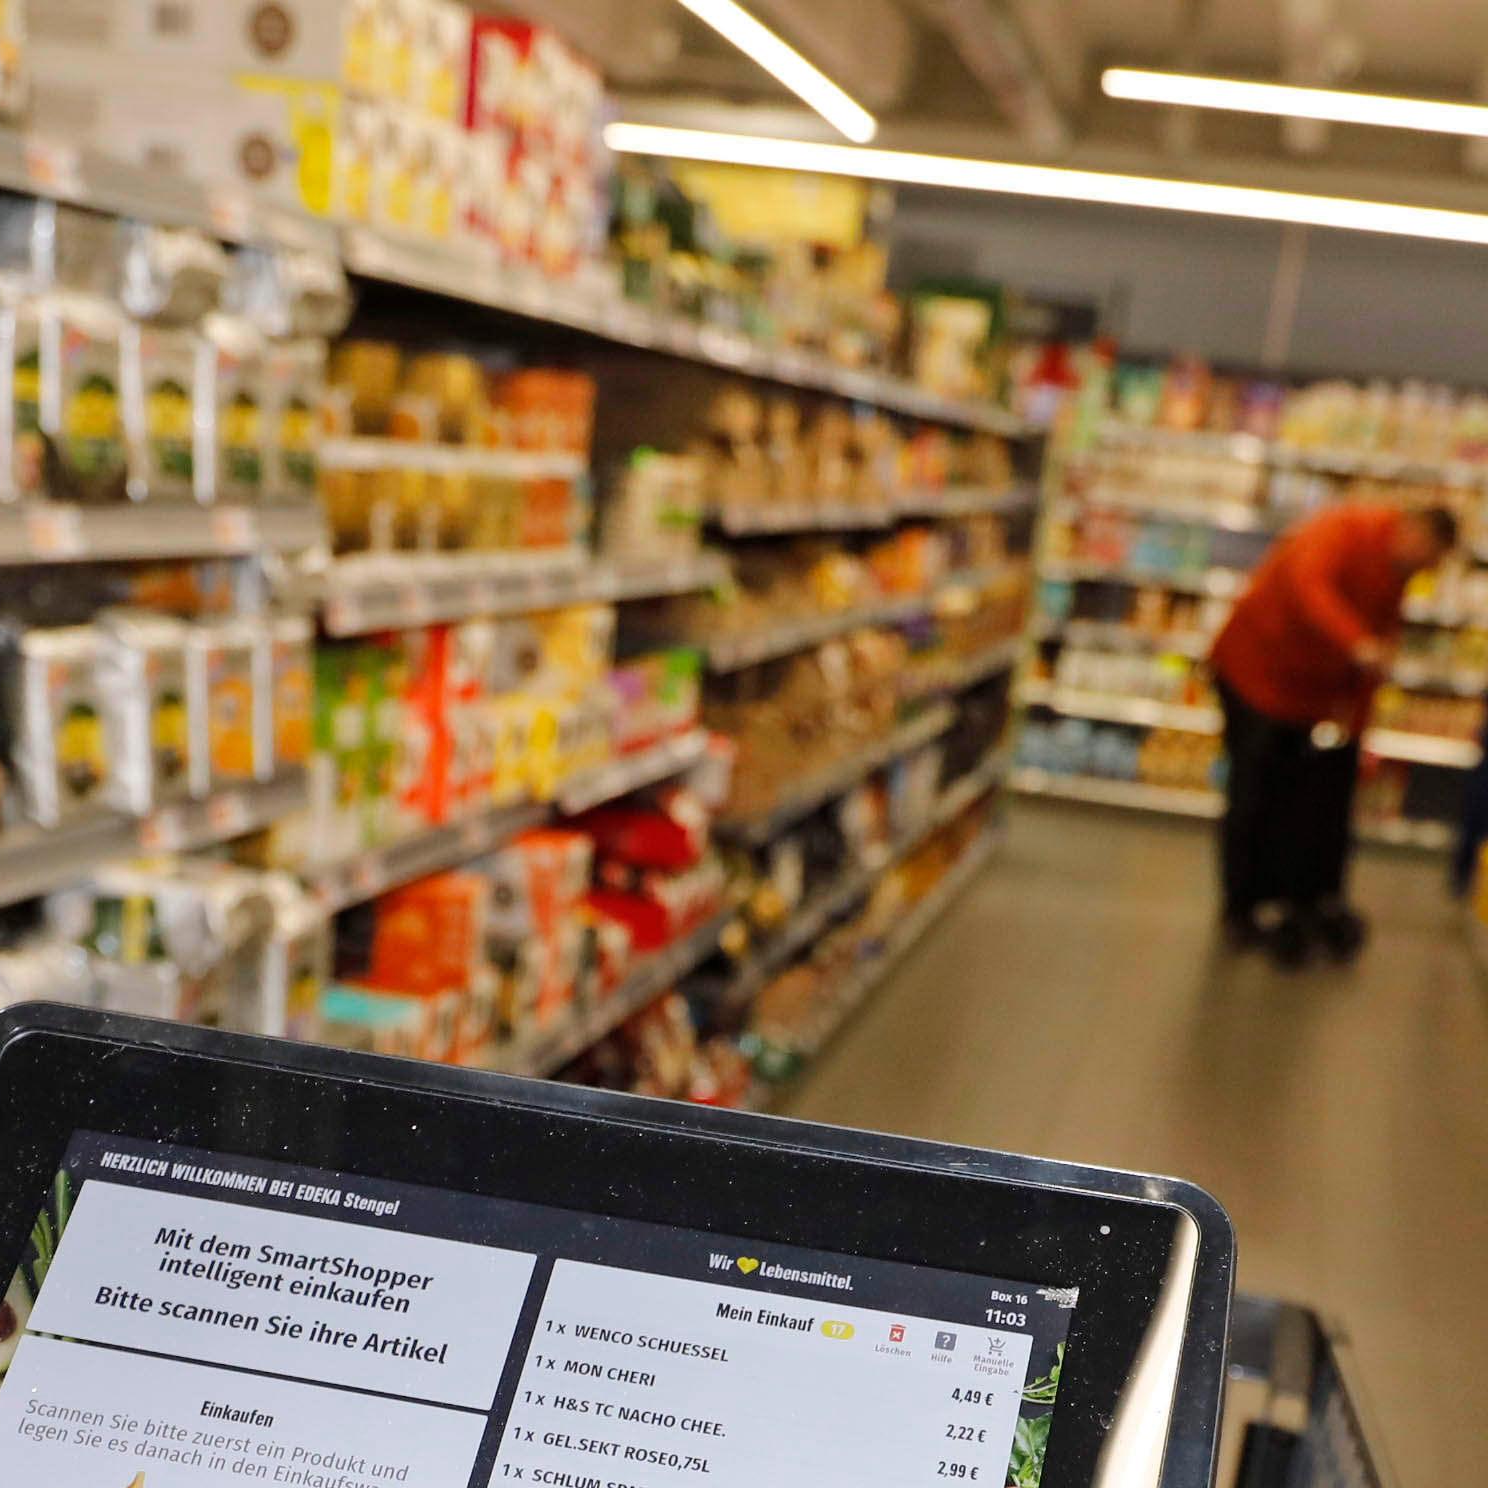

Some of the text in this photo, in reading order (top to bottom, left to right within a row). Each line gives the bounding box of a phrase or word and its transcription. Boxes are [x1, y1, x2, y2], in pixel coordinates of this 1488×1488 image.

[100, 1151, 401, 1216] HERZLICH WILLKOMMEN BEI EDEKA Stengel
[154, 1227, 434, 1290] Mit dem SmartShopper
[159, 1251, 410, 1313] intelligent einkaufen
[709, 1253, 853, 1291] Wir Lebensmittel.
[95, 1286, 448, 1364] Bitte scannen Sie ihre Artikel
[715, 1302, 753, 1322] Mein
[756, 1309, 815, 1332] Einkauf
[985, 1308, 1026, 1327] 11:03
[990, 1290, 1028, 1305] Box 16
[546, 1320, 994, 1406] 1 x WENCO SCHUESSEL 4,49 €
[200, 1400, 274, 1428] Einkaufen
[535, 1355, 987, 1443] 1 x MON CHERI 2,22 €
[17, 1417, 69, 1442] legen
[73, 1429, 103, 1448] Sie
[107, 1438, 129, 1453] es
[134, 1439, 203, 1466] danach
[208, 1452, 226, 1471] in
[232, 1457, 268, 1478] den
[25, 1399, 409, 1481] Scannen Sie bitte zuerst ein Produkt und
[514, 1426, 521, 1440] 1
[524, 1431, 535, 1442] x
[543, 1432, 621, 1457] GEL.SEKT
[624, 1446, 710, 1473] ROSE0,75L
[525, 1391, 979, 1480] 1 x H&S TC NACHO CHEE. 2,99 €
[503, 1463, 511, 1477] 1
[513, 1467, 524, 1479] x
